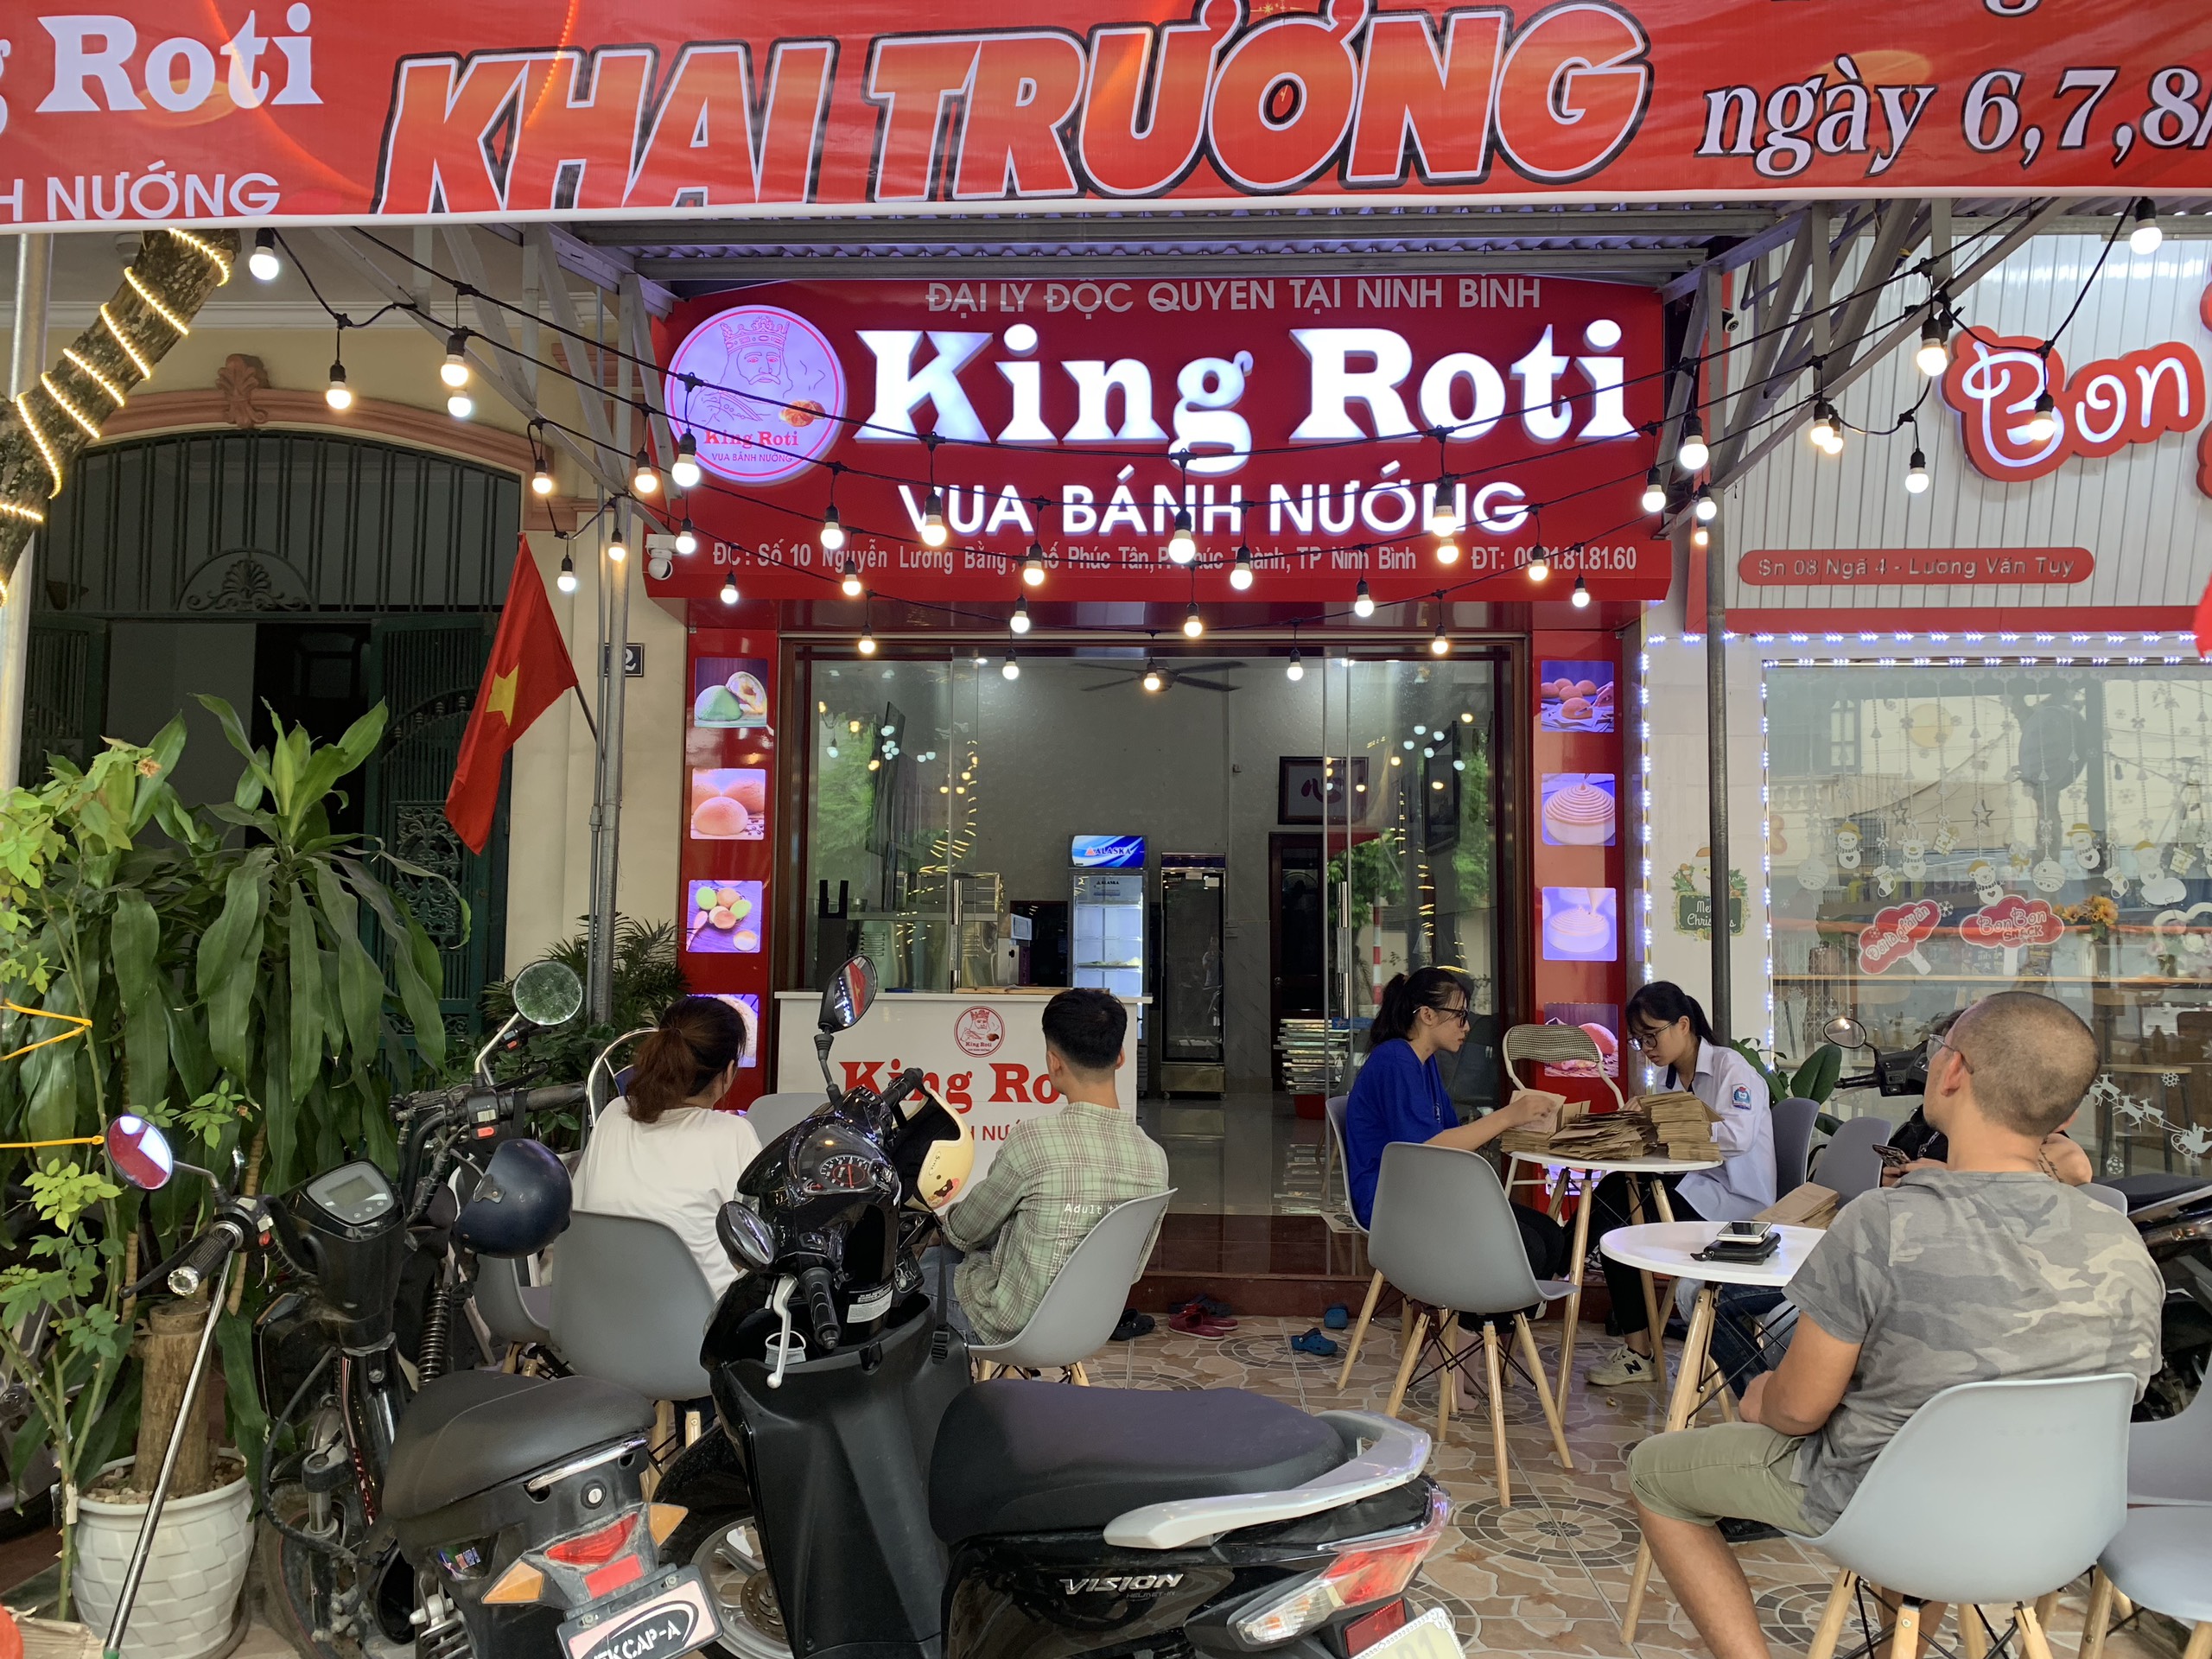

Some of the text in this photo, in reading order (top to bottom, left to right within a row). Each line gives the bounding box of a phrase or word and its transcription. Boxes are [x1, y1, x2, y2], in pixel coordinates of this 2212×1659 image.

[35, 2, 324, 113] Roti
[371, 37, 836, 216] KHAI
[1694, 54, 1937, 178] ngày
[48, 160, 280, 221] NƯỚNG
[925, 282, 987, 319] ĐẠI
[1289, 279, 1340, 315] TẠI
[1357, 278, 1442, 308] NINH
[852, 319, 1641, 477] King Roti
[1961, 341, 2190, 467] Bon
[703, 429, 798, 449] King Roti
[712, 453, 730, 461] VUA
[734, 451, 757, 462] BÁNH
[898, 459, 1529, 537] VUA BÁNH NƯỚNG
[757, 539, 782, 566] Số
[790, 543, 810, 566] 10
[899, 545, 954, 574] Lương
[1026, 542, 1059, 569] hố
[1068, 543, 1111, 570] Phúc
[1180, 545, 1224, 570] úc
[1297, 546, 1322, 569] TP
[1332, 545, 1370, 570] Ninh
[1378, 544, 1416, 570] Bình
[1471, 546, 1505, 569] ĐT:
[1758, 558, 1787, 576] Sn
[1794, 558, 1820, 576] 08
[1875, 557, 1887, 576] 4
[1095, 847, 1132, 855] ALASKA
[1064, 1203, 1103, 1215] Adult
[1058, 1573, 1184, 1595] VISION
